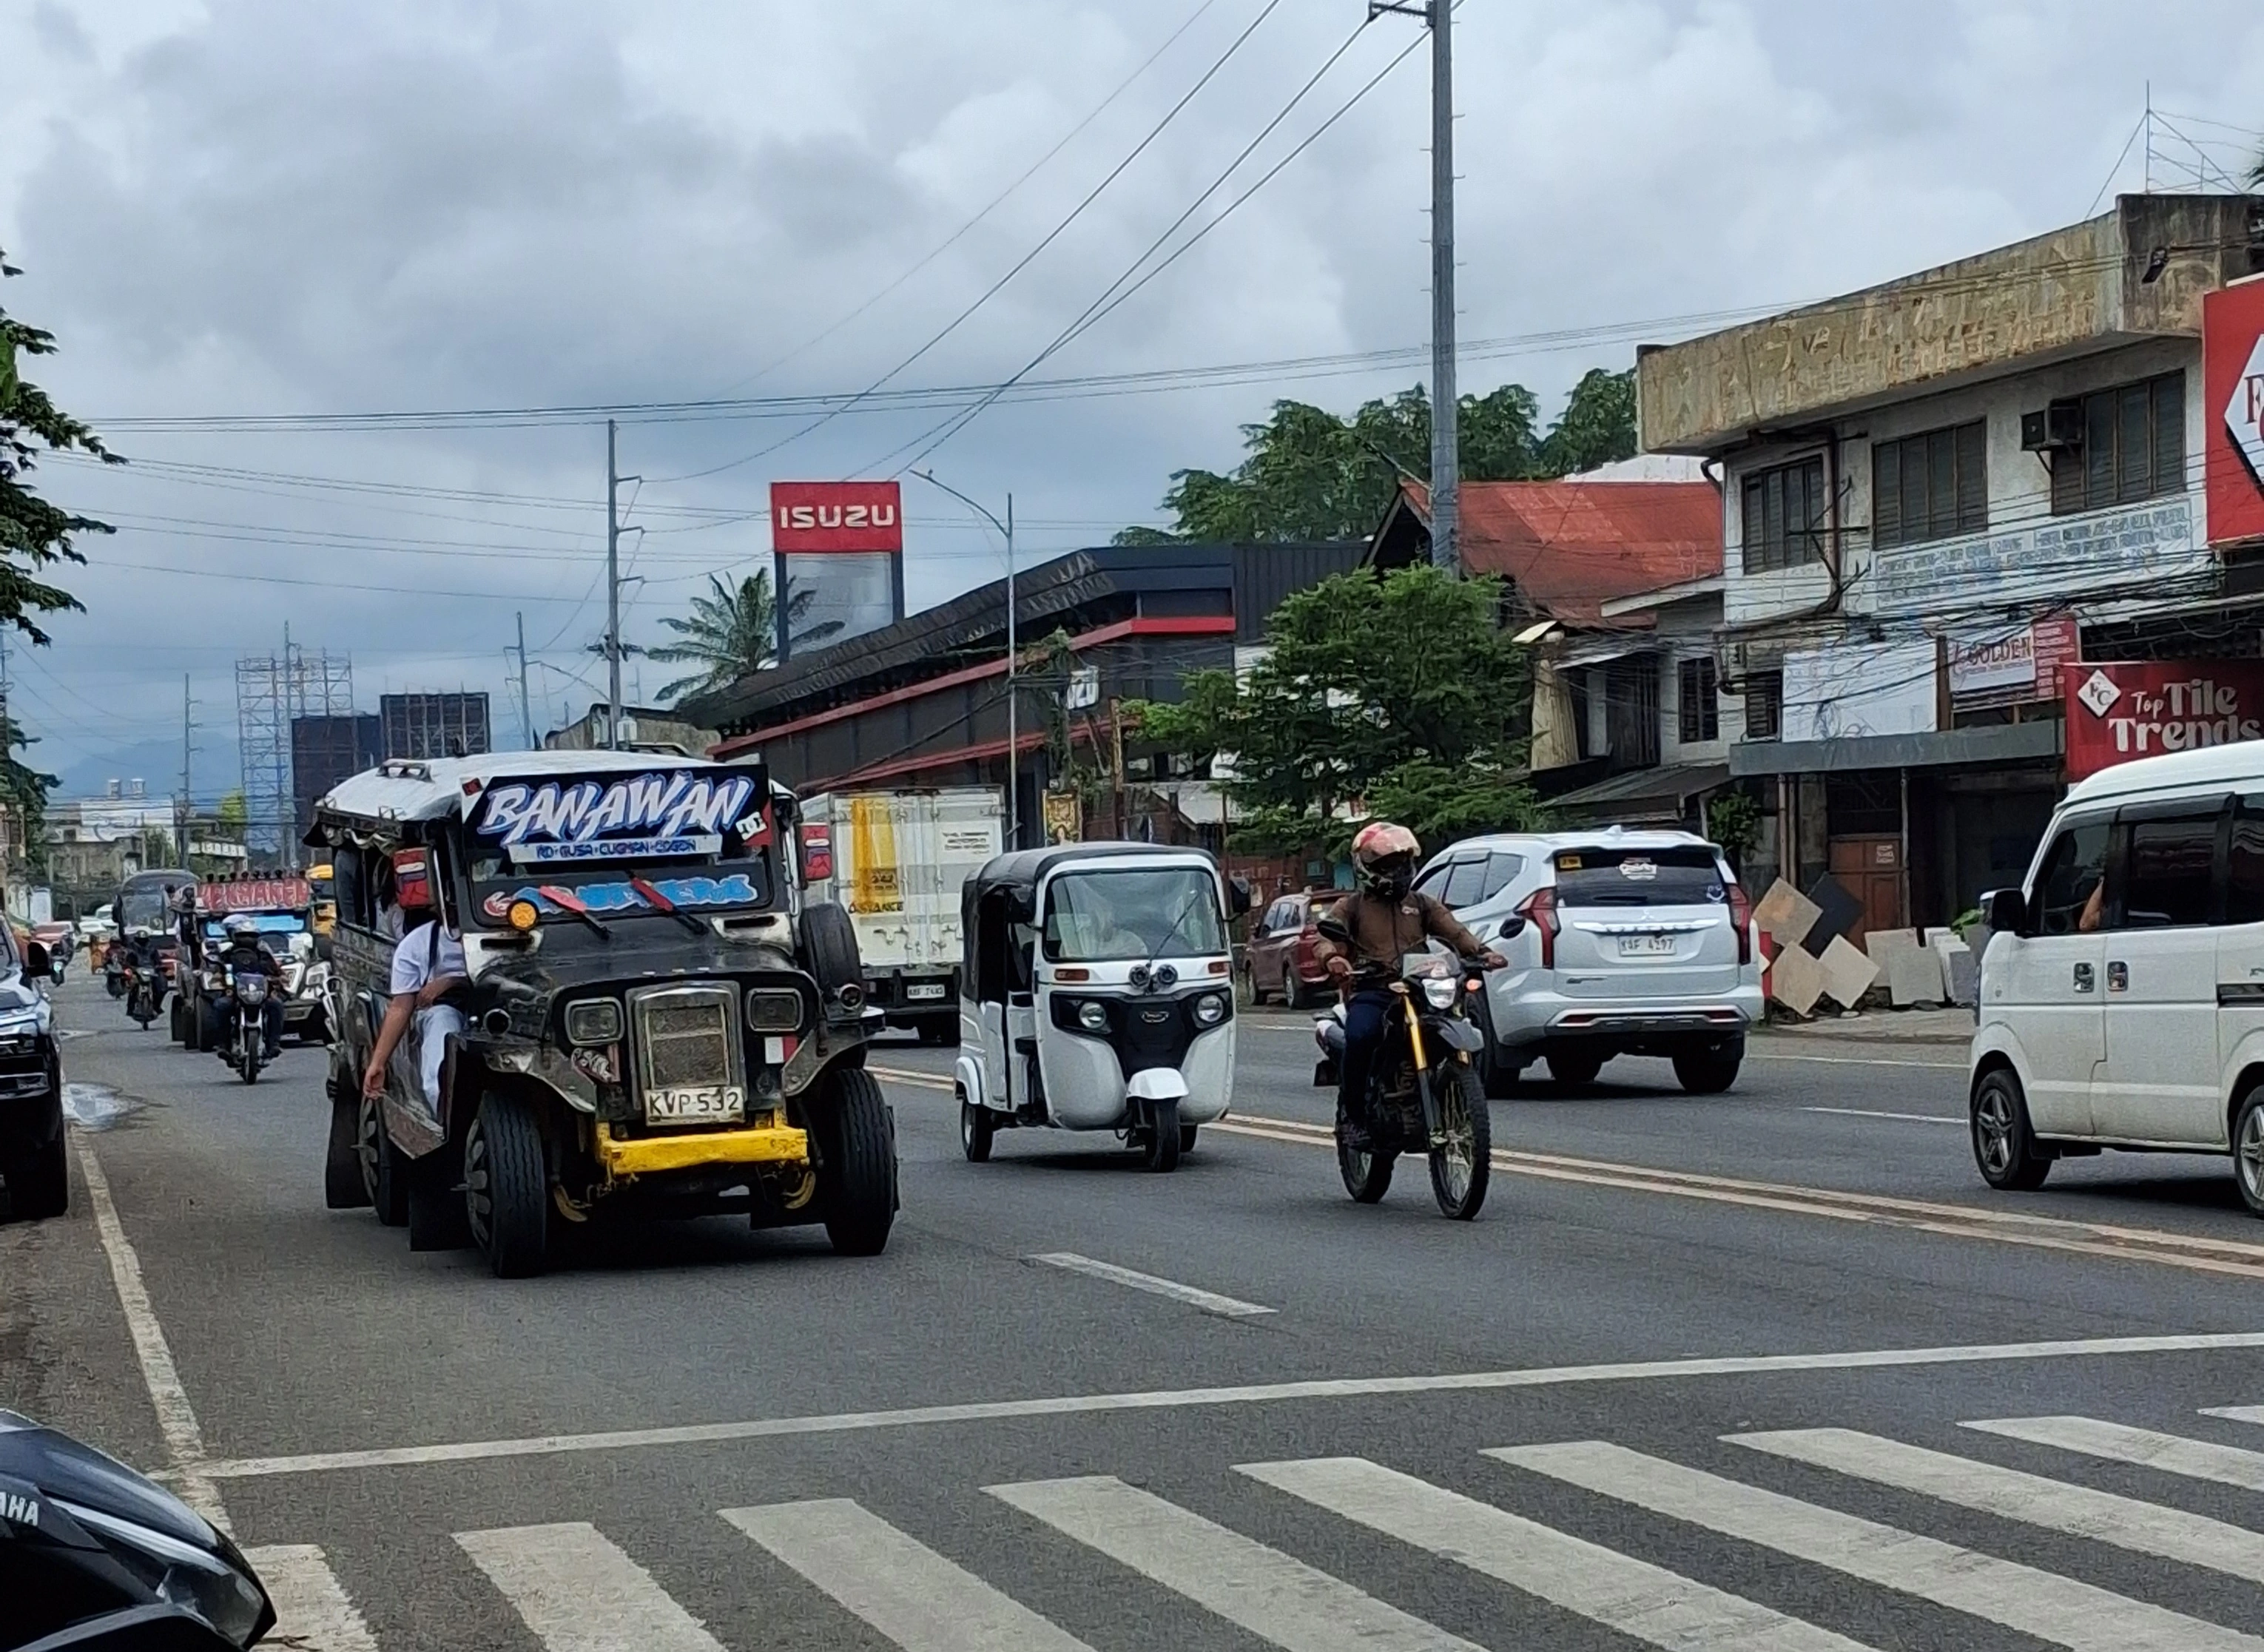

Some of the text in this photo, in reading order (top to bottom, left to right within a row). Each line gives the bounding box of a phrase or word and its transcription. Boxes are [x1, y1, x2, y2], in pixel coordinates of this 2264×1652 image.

[780, 505, 894, 529] ISUZU
[2131, 678, 2238, 719] Top Tile
[2108, 715, 2263, 752] Trends
[479, 771, 755, 849] BANAWAN
